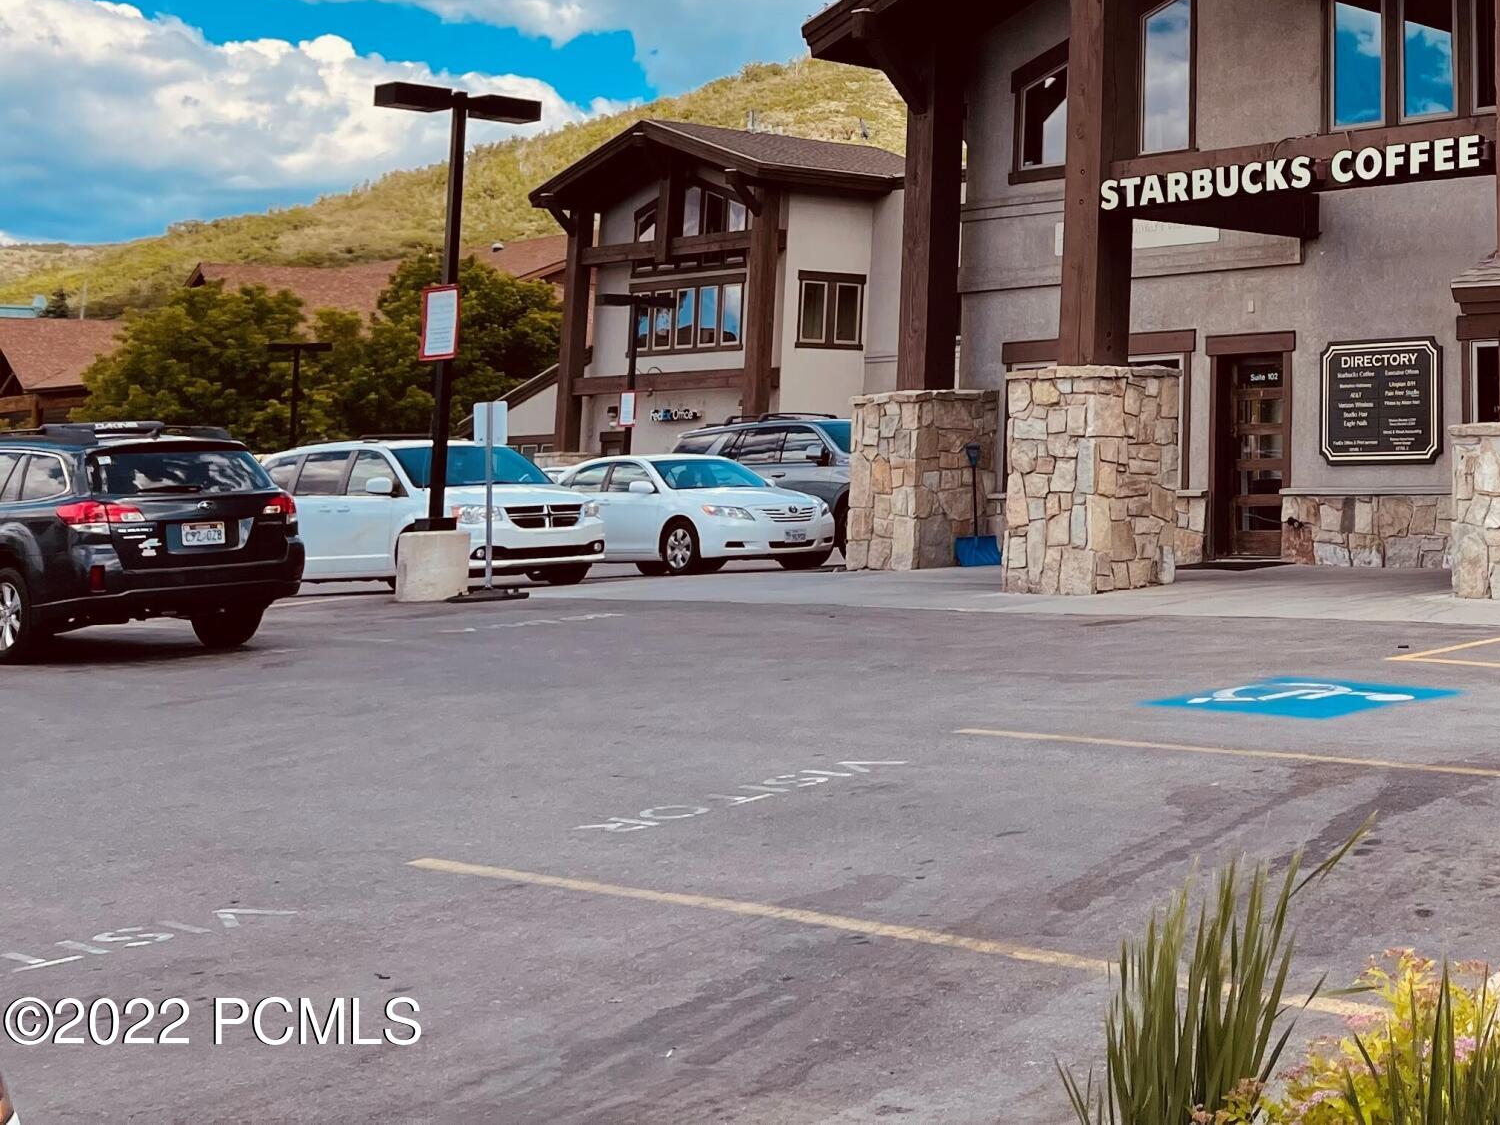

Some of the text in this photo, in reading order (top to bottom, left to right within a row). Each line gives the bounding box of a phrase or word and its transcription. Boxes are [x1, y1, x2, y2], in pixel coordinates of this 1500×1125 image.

[1100, 134, 1481, 211] STARBUCKS COFFEE
[1341, 353, 1418, 368] DIRECTORY
[1250, 372, 1279, 381] Suite 102
[651, 409, 672, 421] FedEx
[570, 761, 909, 832] VISITOR
